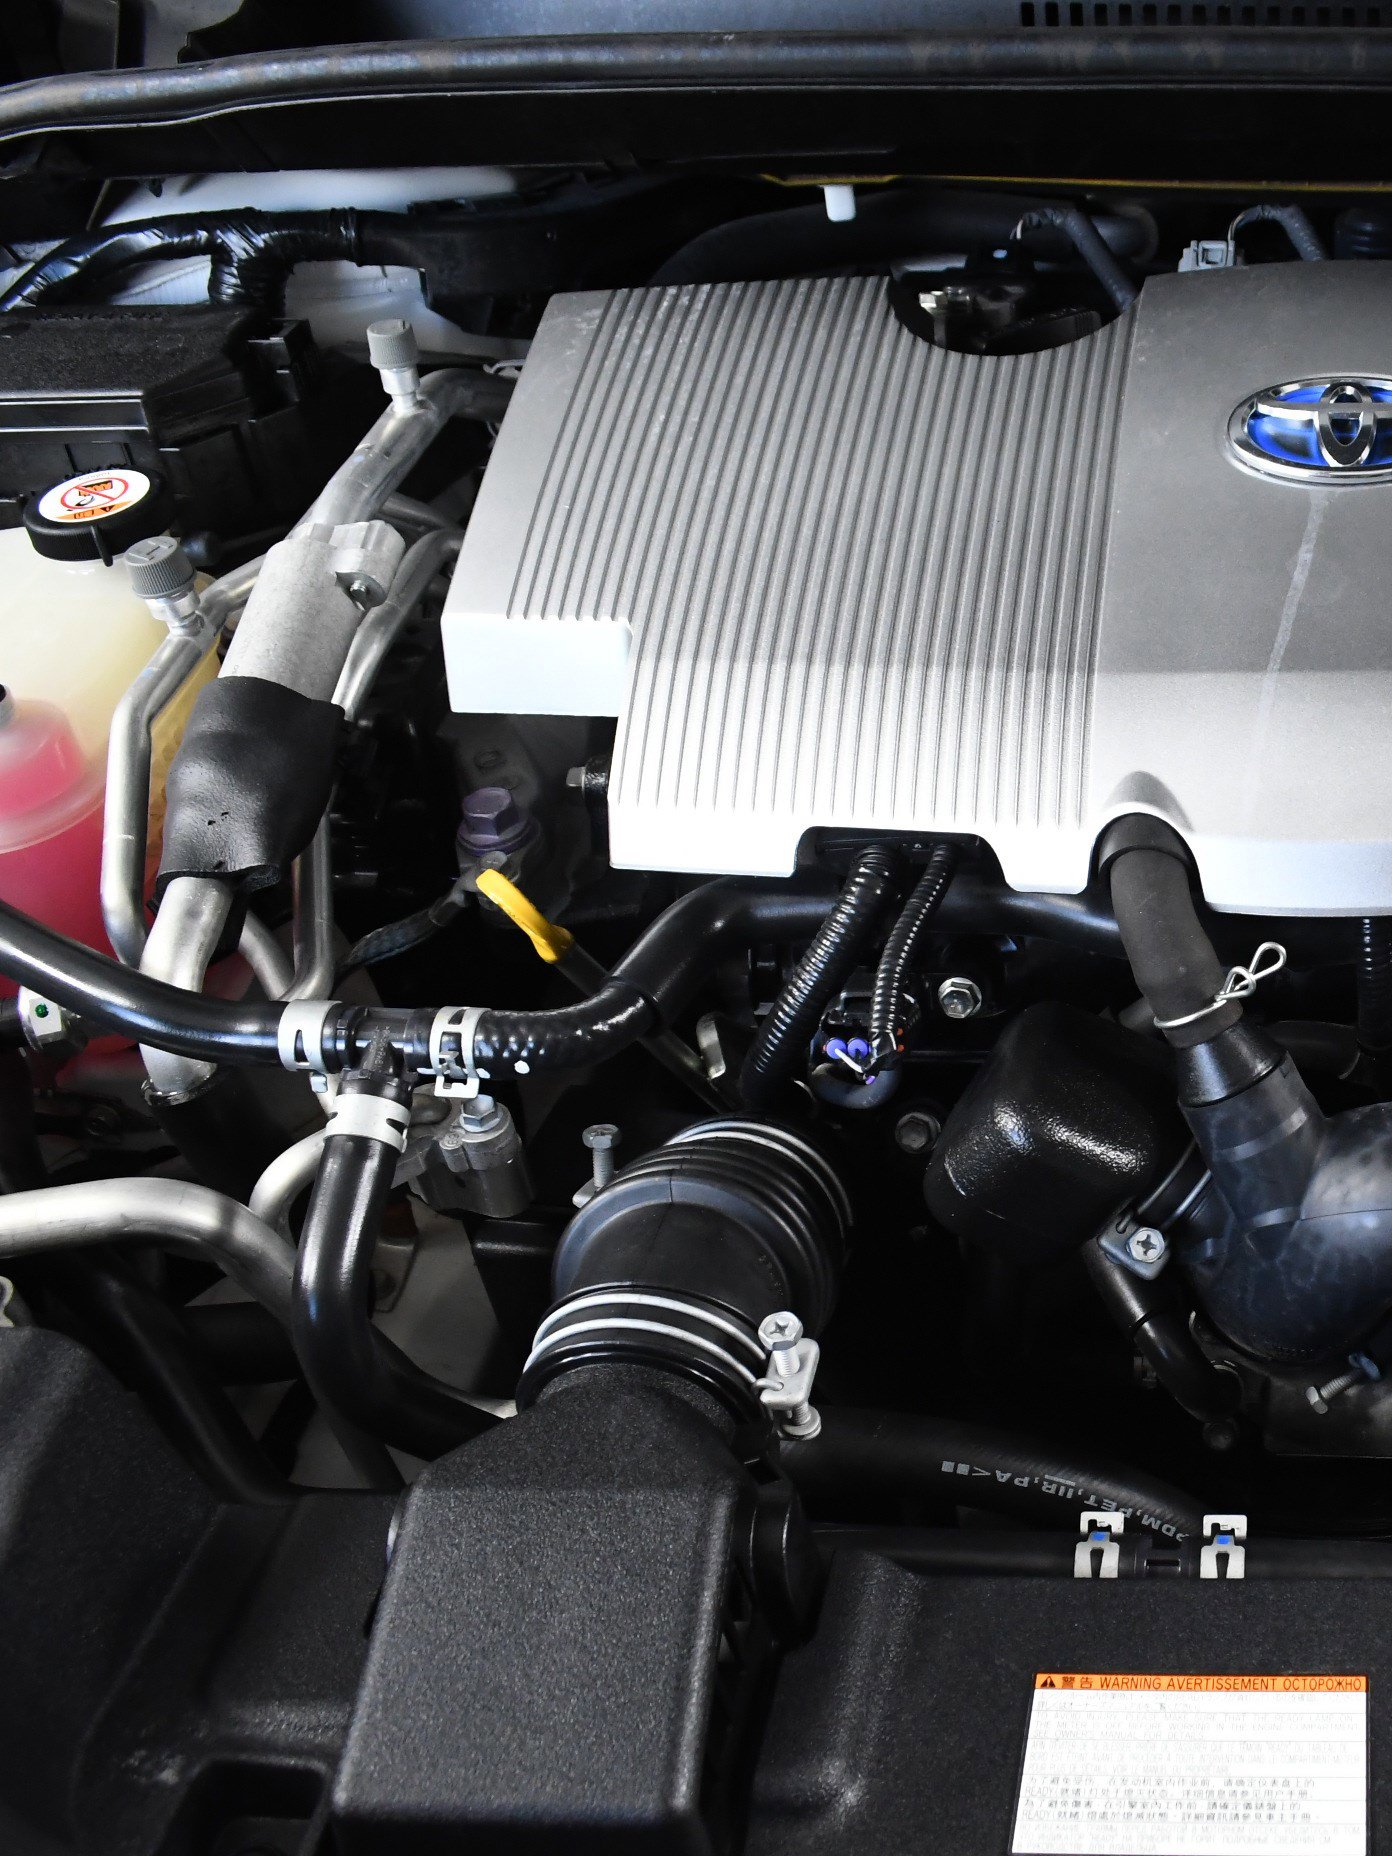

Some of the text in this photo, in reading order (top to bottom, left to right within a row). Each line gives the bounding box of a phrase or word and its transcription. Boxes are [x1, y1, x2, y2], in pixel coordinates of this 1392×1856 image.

[1100, 1676, 1278, 1692] WARNING AVERTISSEMENT
[1282, 1678, 1362, 1692] ОСТОРОЖНО
